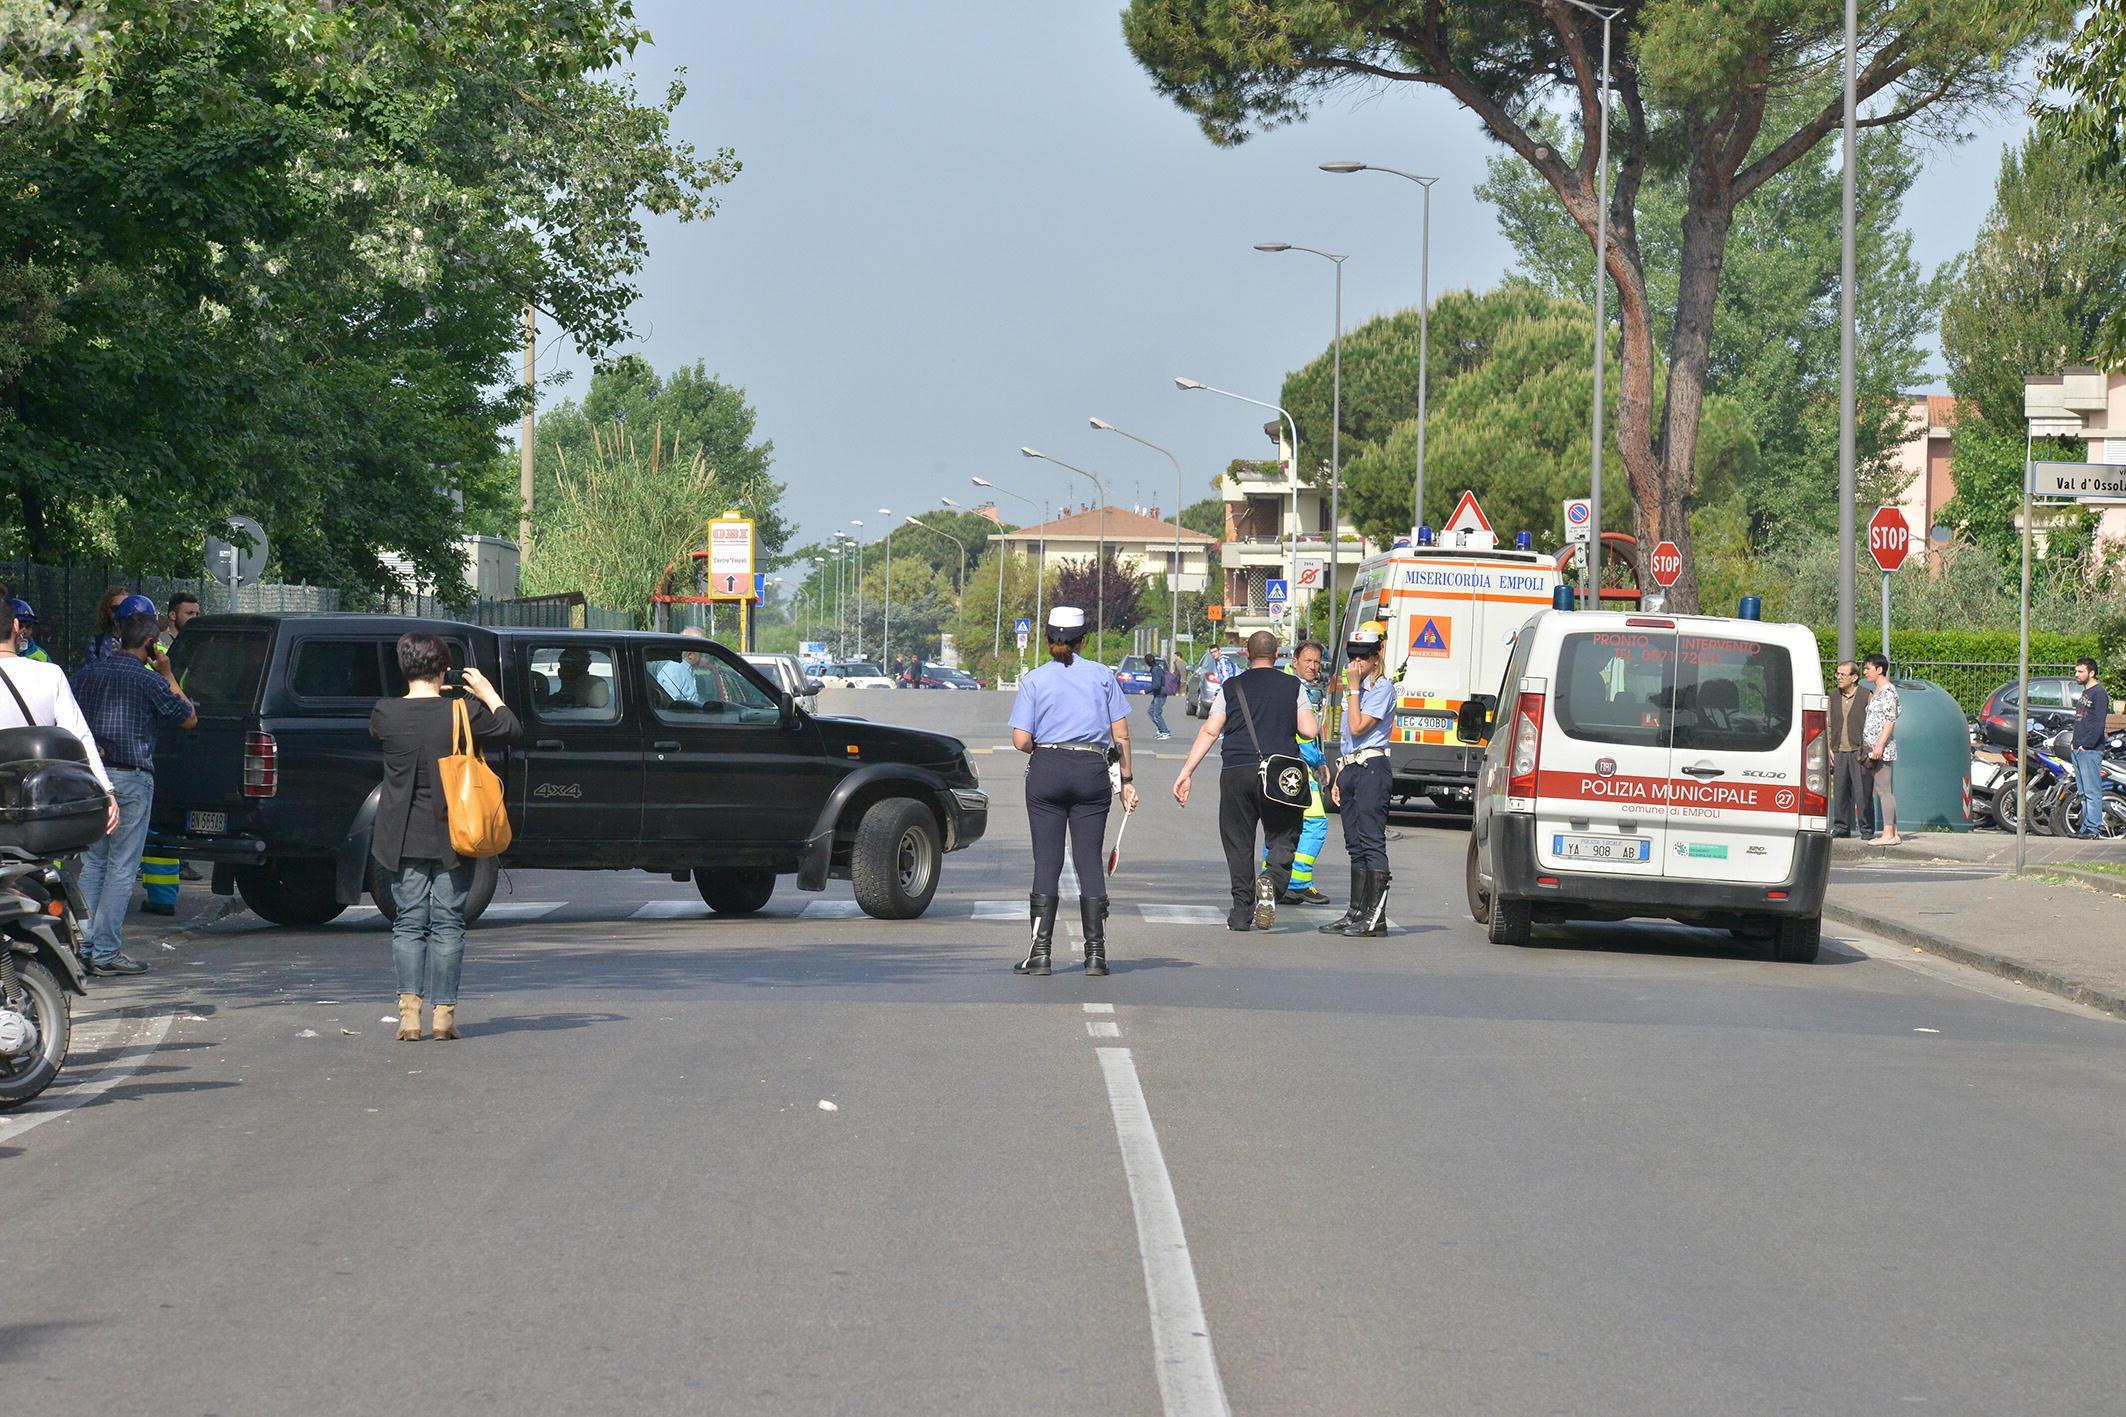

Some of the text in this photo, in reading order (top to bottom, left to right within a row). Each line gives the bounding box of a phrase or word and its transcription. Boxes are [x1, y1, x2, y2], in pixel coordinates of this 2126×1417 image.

[2056, 477, 2075, 490] Val
[713, 528, 748, 539] OBI
[1872, 526, 1908, 551] STOP
[1653, 555, 1680, 573] STOP
[1405, 570, 1544, 591] MISERICORDIA EMPOLI
[1592, 633, 1761, 655] PRONTO INTERVENTO
[1406, 690, 1435, 698] IVECO
[1403, 716, 1415, 727] EG
[1417, 717, 1447, 729] 490BD
[1600, 761, 1613, 772] FIAT
[1741, 769, 1787, 779] SCUDO
[533, 783, 582, 799] 4x4
[1580, 779, 1792, 805] POLIZIA MUNICIPALE 27
[1621, 804, 1721, 819] comune di EMPOLI
[1568, 843, 1579, 855] YA
[1593, 845, 1611, 857] 908
[1622, 847, 1635, 858] AB
